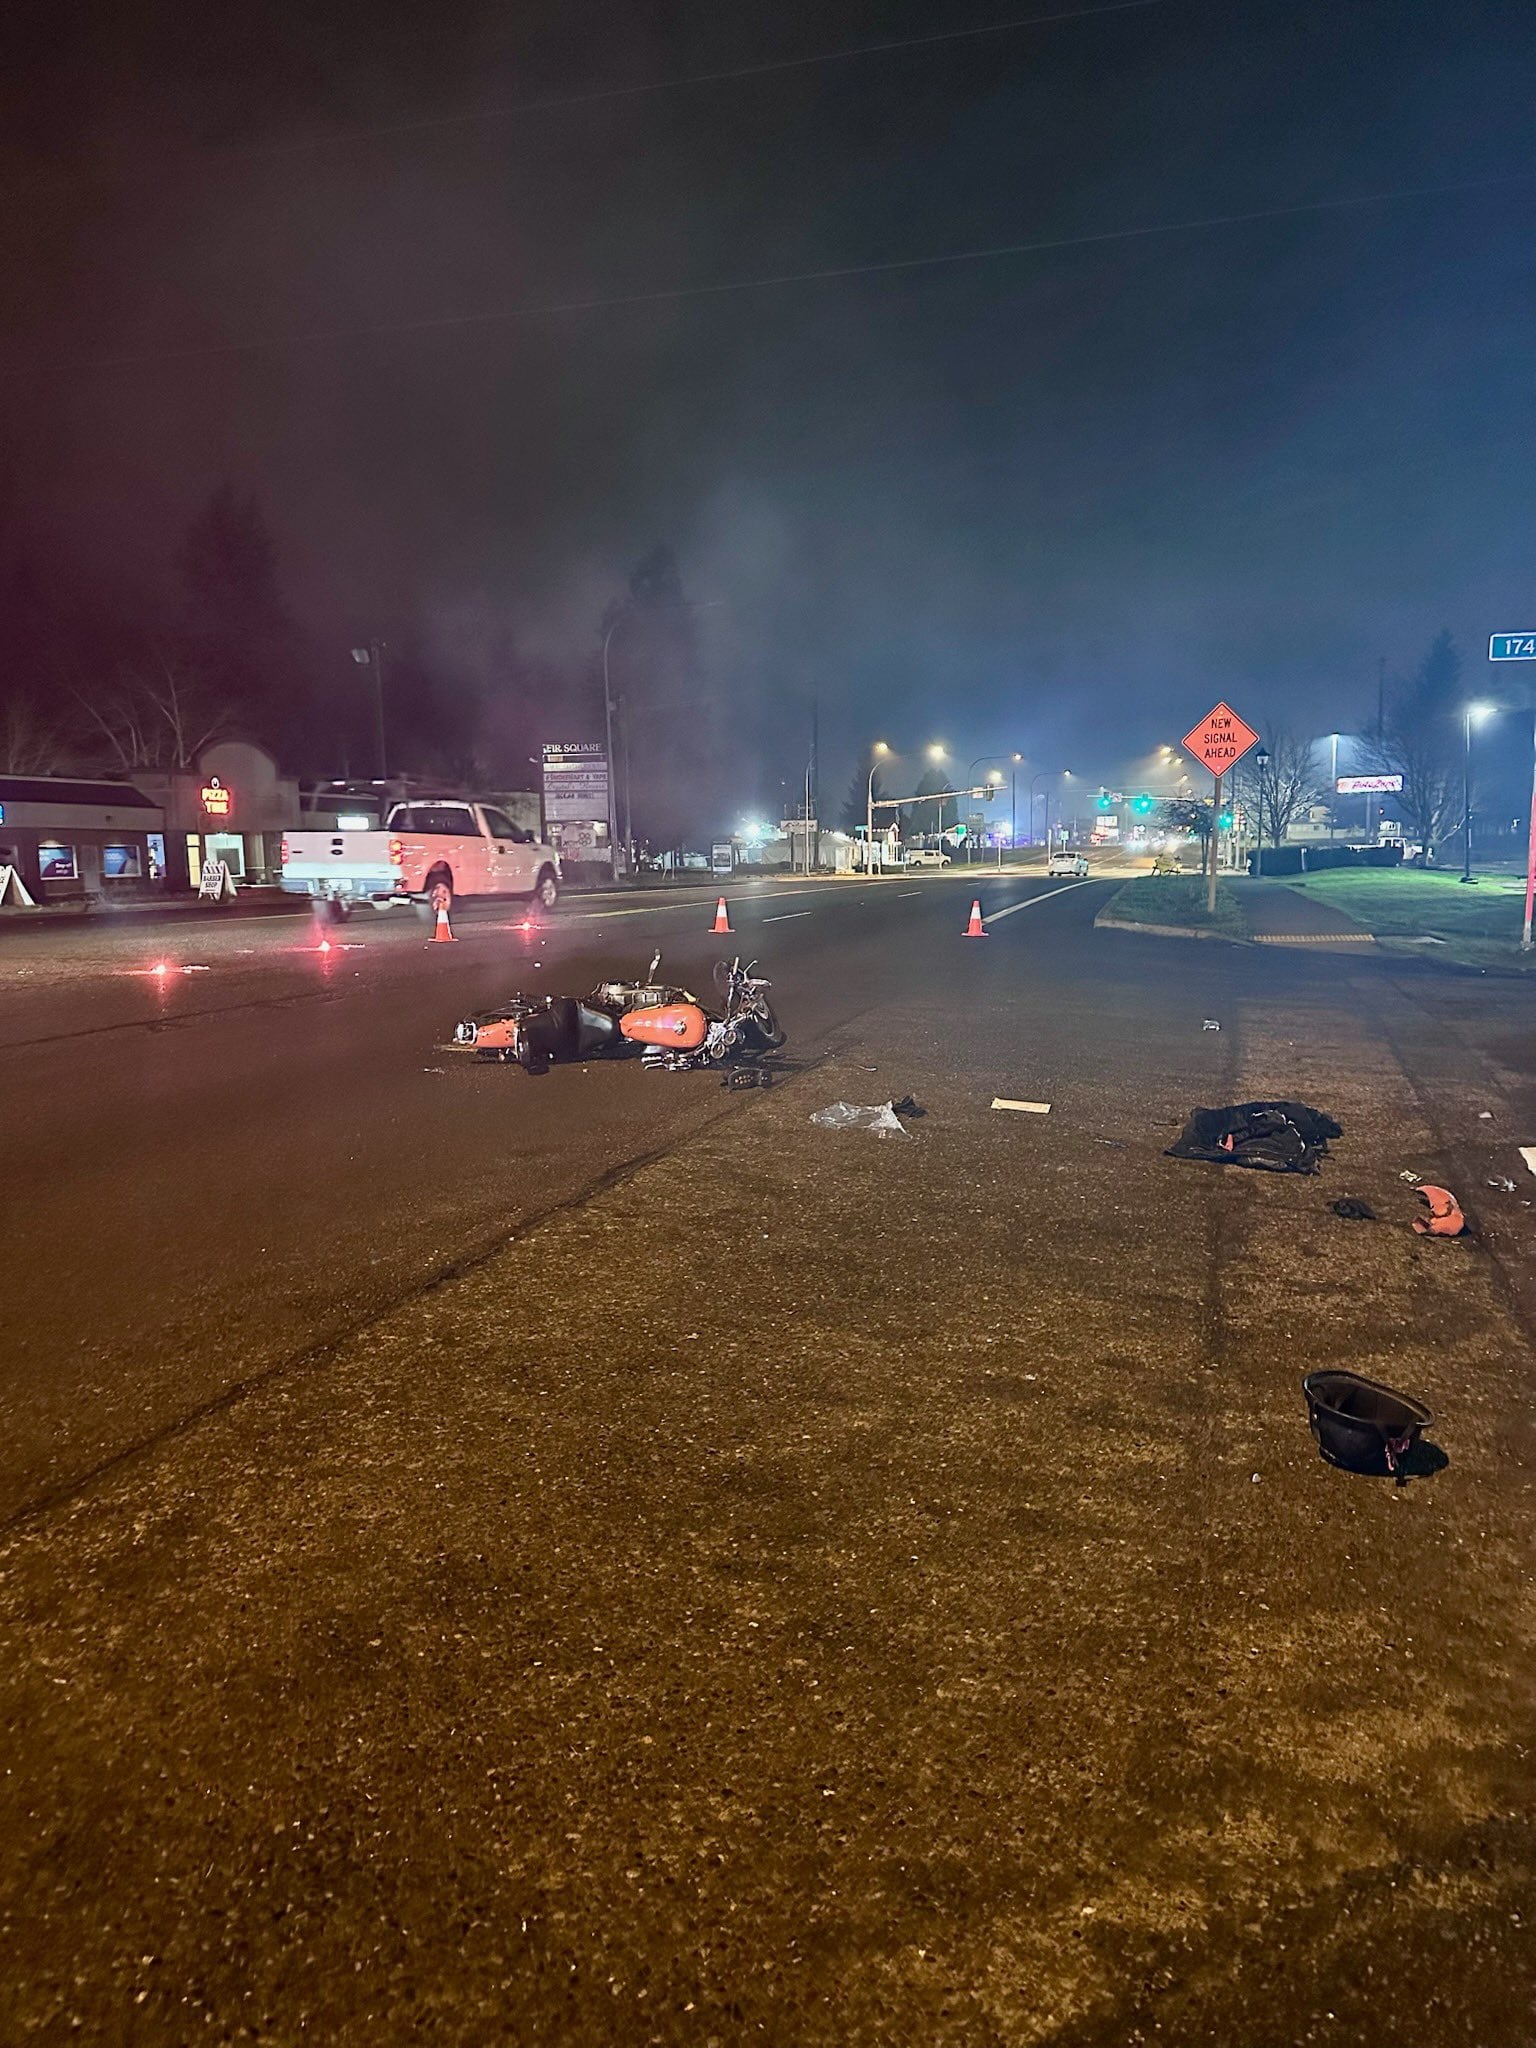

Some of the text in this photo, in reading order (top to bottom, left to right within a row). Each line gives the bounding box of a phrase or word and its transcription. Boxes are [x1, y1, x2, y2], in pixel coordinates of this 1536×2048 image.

[1505, 639, 1535, 655] 174
[1211, 718, 1232, 729] NEW
[1203, 733, 1238, 744] SIGNAL
[563, 743, 603, 753] SQUARE
[1204, 747, 1236, 758] AHEAD
